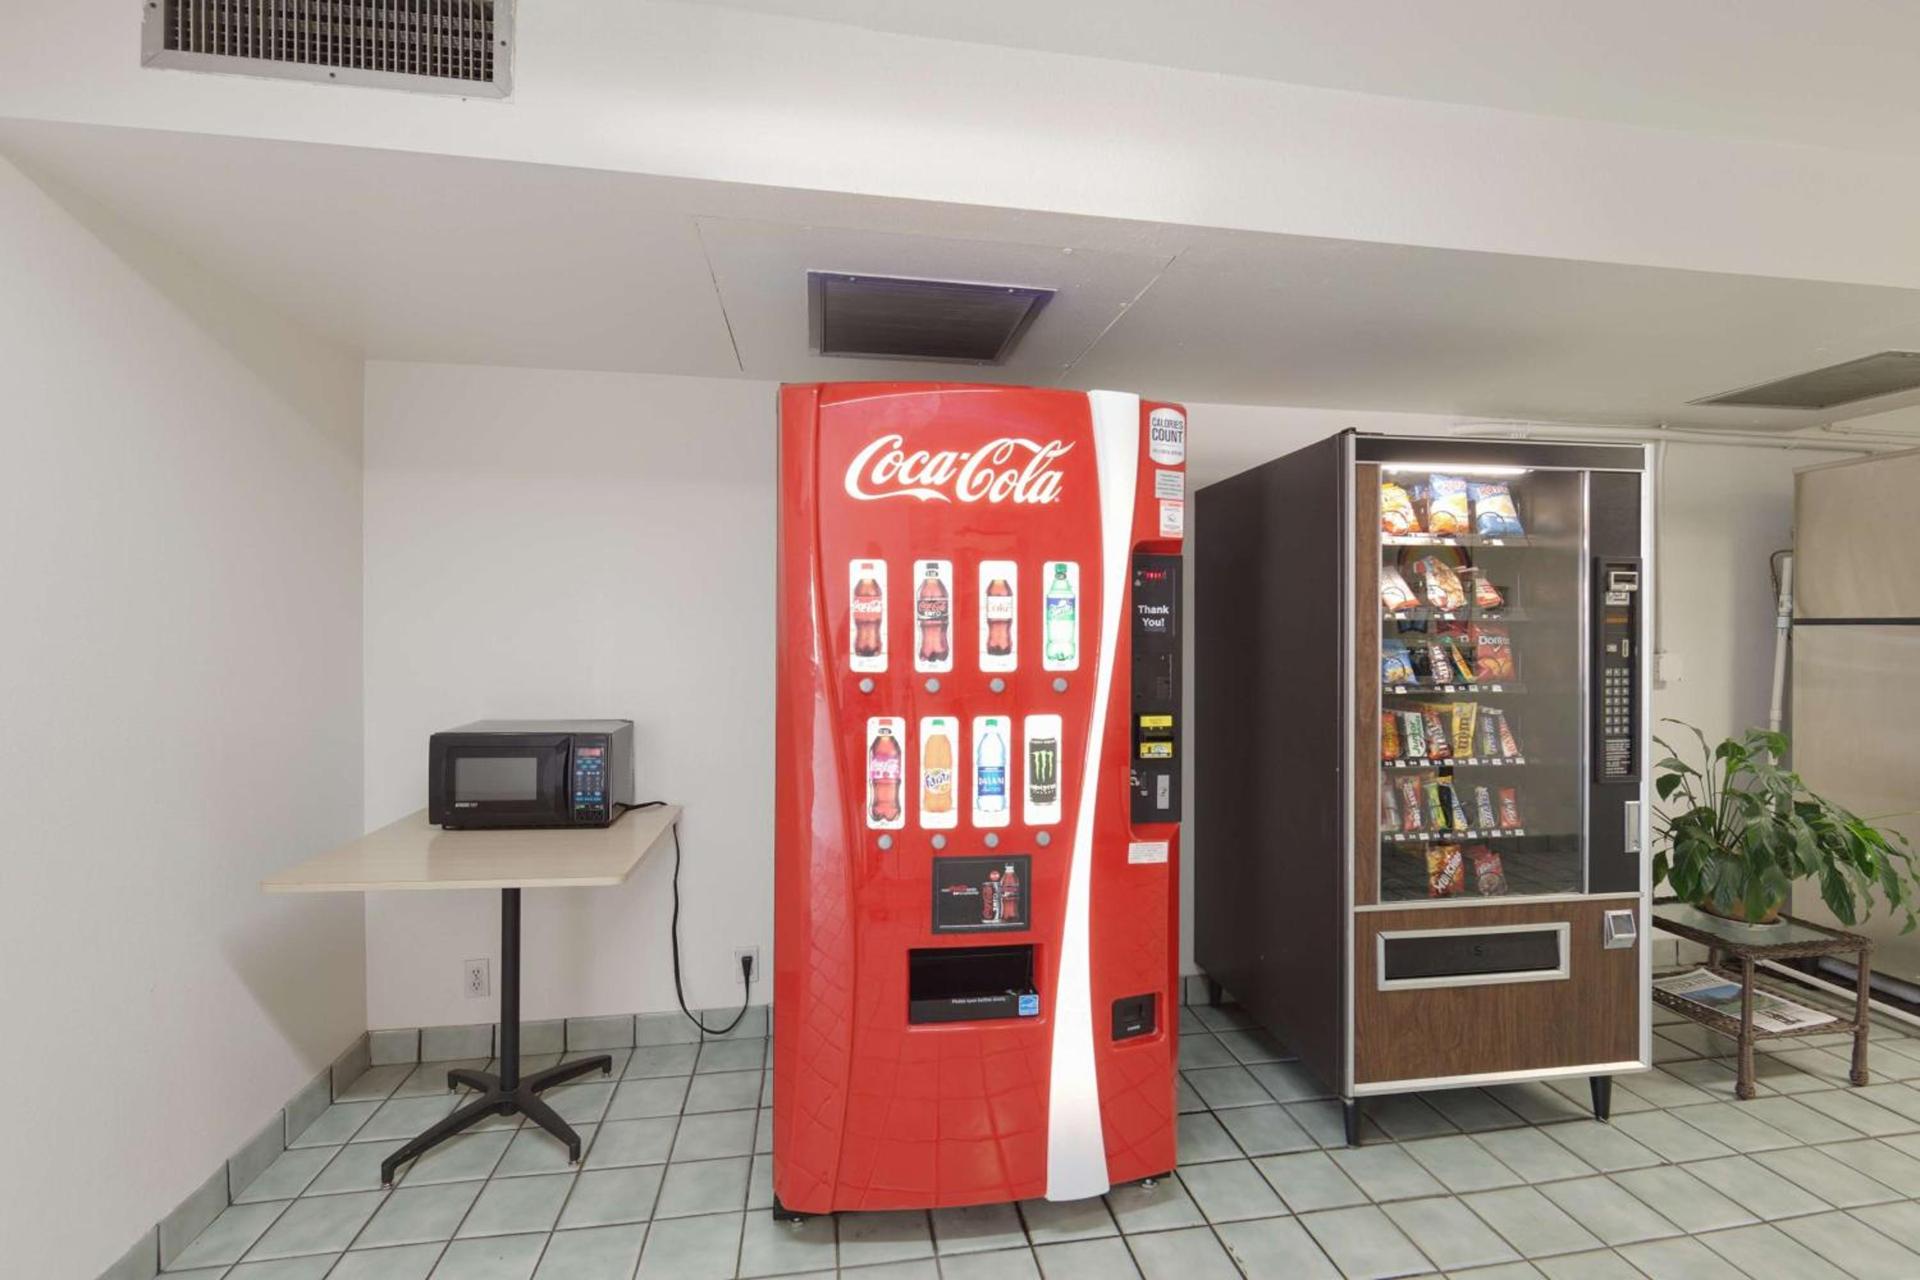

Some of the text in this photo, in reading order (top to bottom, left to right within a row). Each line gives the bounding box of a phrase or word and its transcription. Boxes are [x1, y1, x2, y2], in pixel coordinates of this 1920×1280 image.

[1151, 417, 1184, 429] CALORIES
[1151, 428, 1183, 444] COUNT
[845, 434, 1076, 504] Coca-Cola
[1138, 605, 1169, 615] Thank
[1142, 618, 1165, 628] You!
